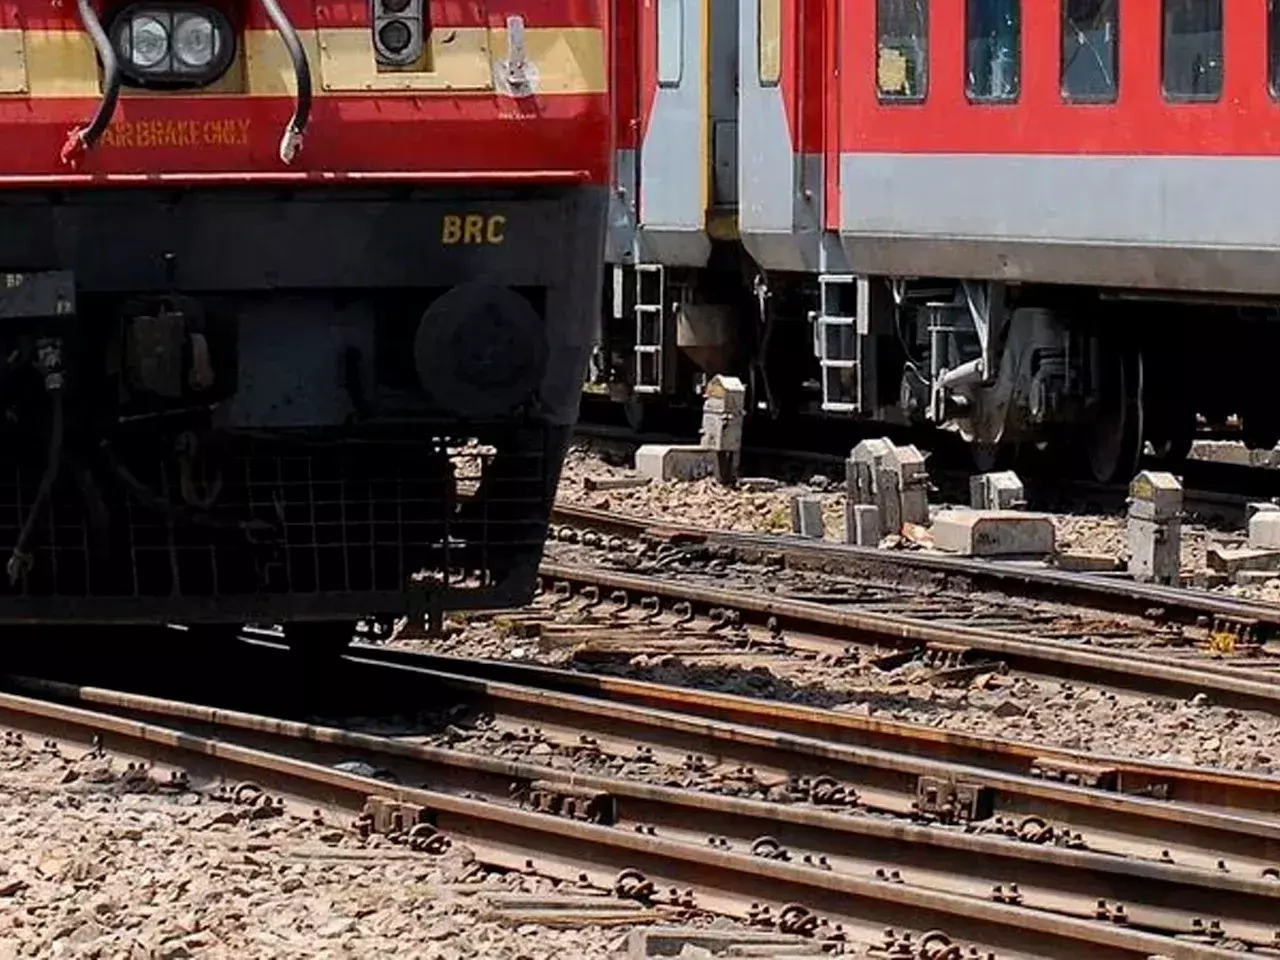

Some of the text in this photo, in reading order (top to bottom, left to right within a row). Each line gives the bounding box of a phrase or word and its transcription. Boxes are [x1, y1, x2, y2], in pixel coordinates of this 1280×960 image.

[136, 117, 200, 147] BRAKE
[204, 116, 251, 145] ONLY
[442, 214, 507, 244] BRC
